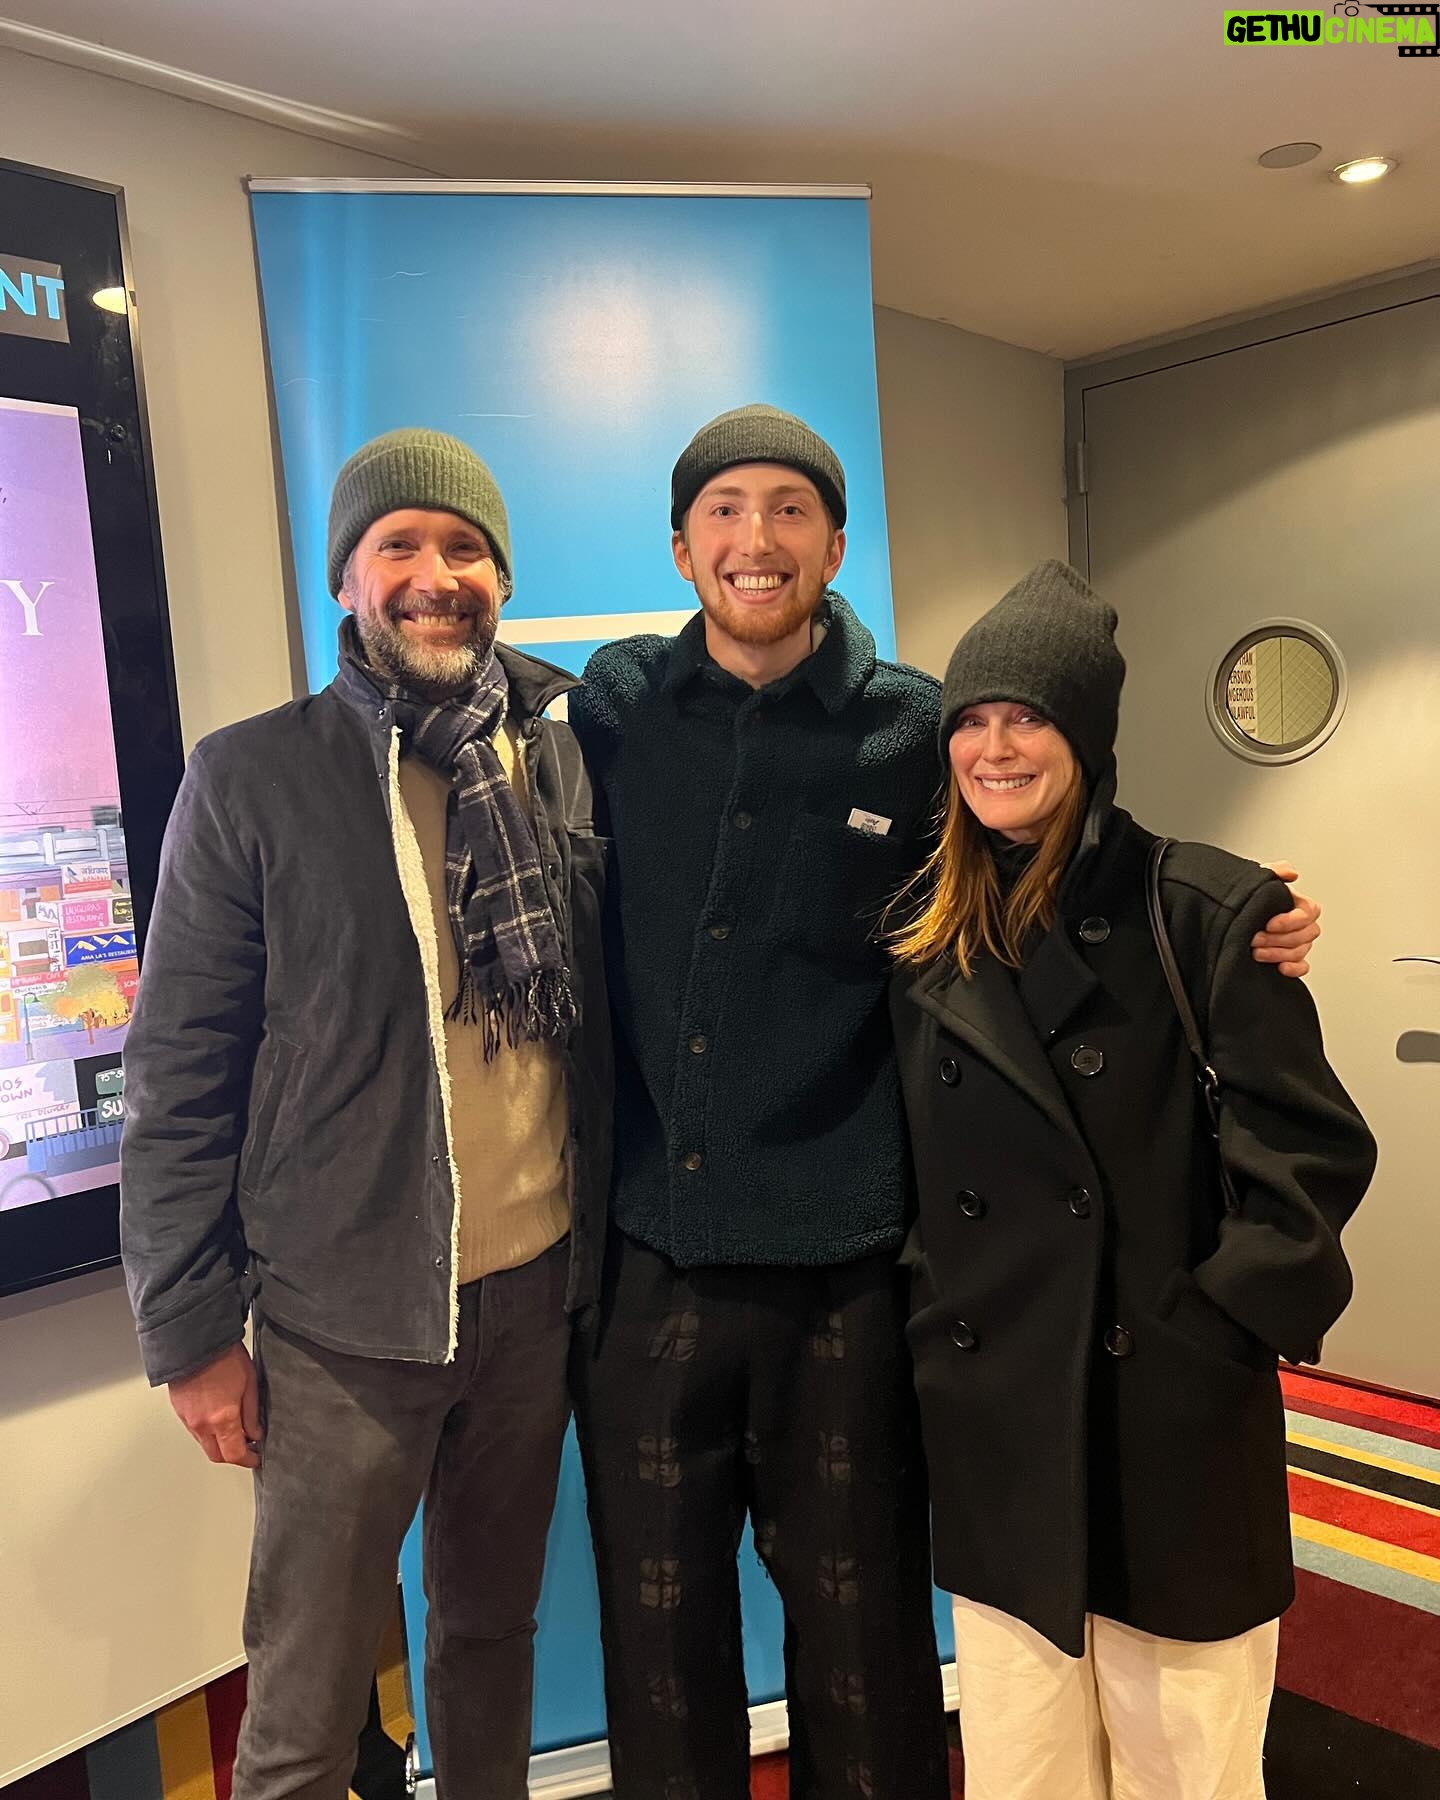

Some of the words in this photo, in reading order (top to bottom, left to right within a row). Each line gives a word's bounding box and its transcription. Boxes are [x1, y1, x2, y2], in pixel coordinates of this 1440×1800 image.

[0, 267, 65, 320] NT
[0, 579, 56, 637] Y
[0, 1077, 22, 1092] OS
[1, 1087, 33, 1103] OWN
[101, 1099, 124, 1119] SU
